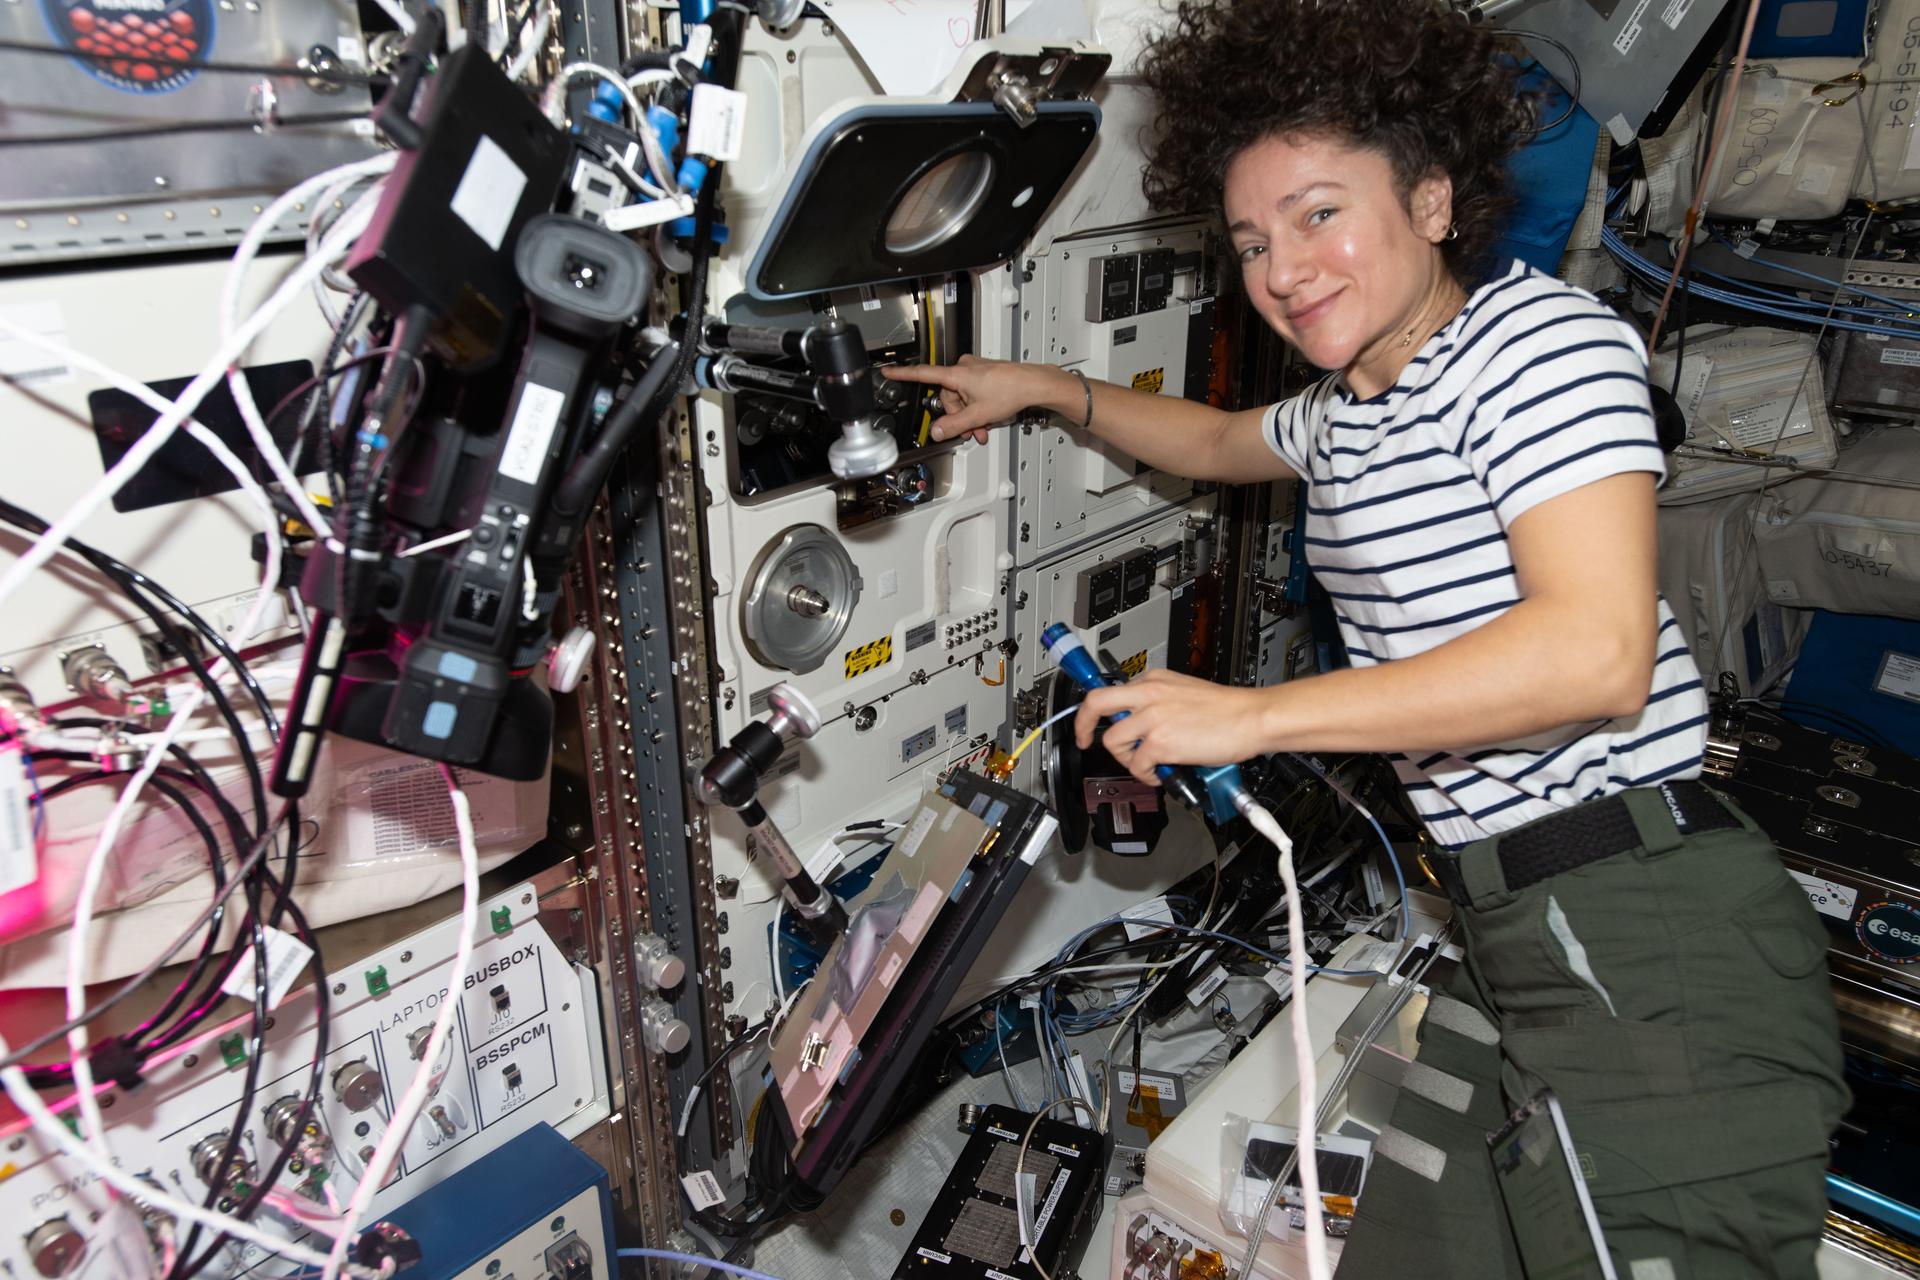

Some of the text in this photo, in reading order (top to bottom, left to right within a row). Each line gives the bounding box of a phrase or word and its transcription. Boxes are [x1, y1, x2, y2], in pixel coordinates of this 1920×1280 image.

[1660, 783, 1687, 826] ARCADE
[1888, 927, 1920, 947] esa
[464, 943, 537, 991] BUSBOX
[379, 987, 450, 1033] LAPTOP
[488, 1017, 515, 1036] RS232
[476, 1022, 546, 1070] BSSPCM
[500, 1094, 527, 1113] RS232
[1032, 1214, 1048, 1241] ORTABLE
[1044, 1195, 1057, 1215] POWER
[1052, 1175, 1066, 1196] SUPPLY
